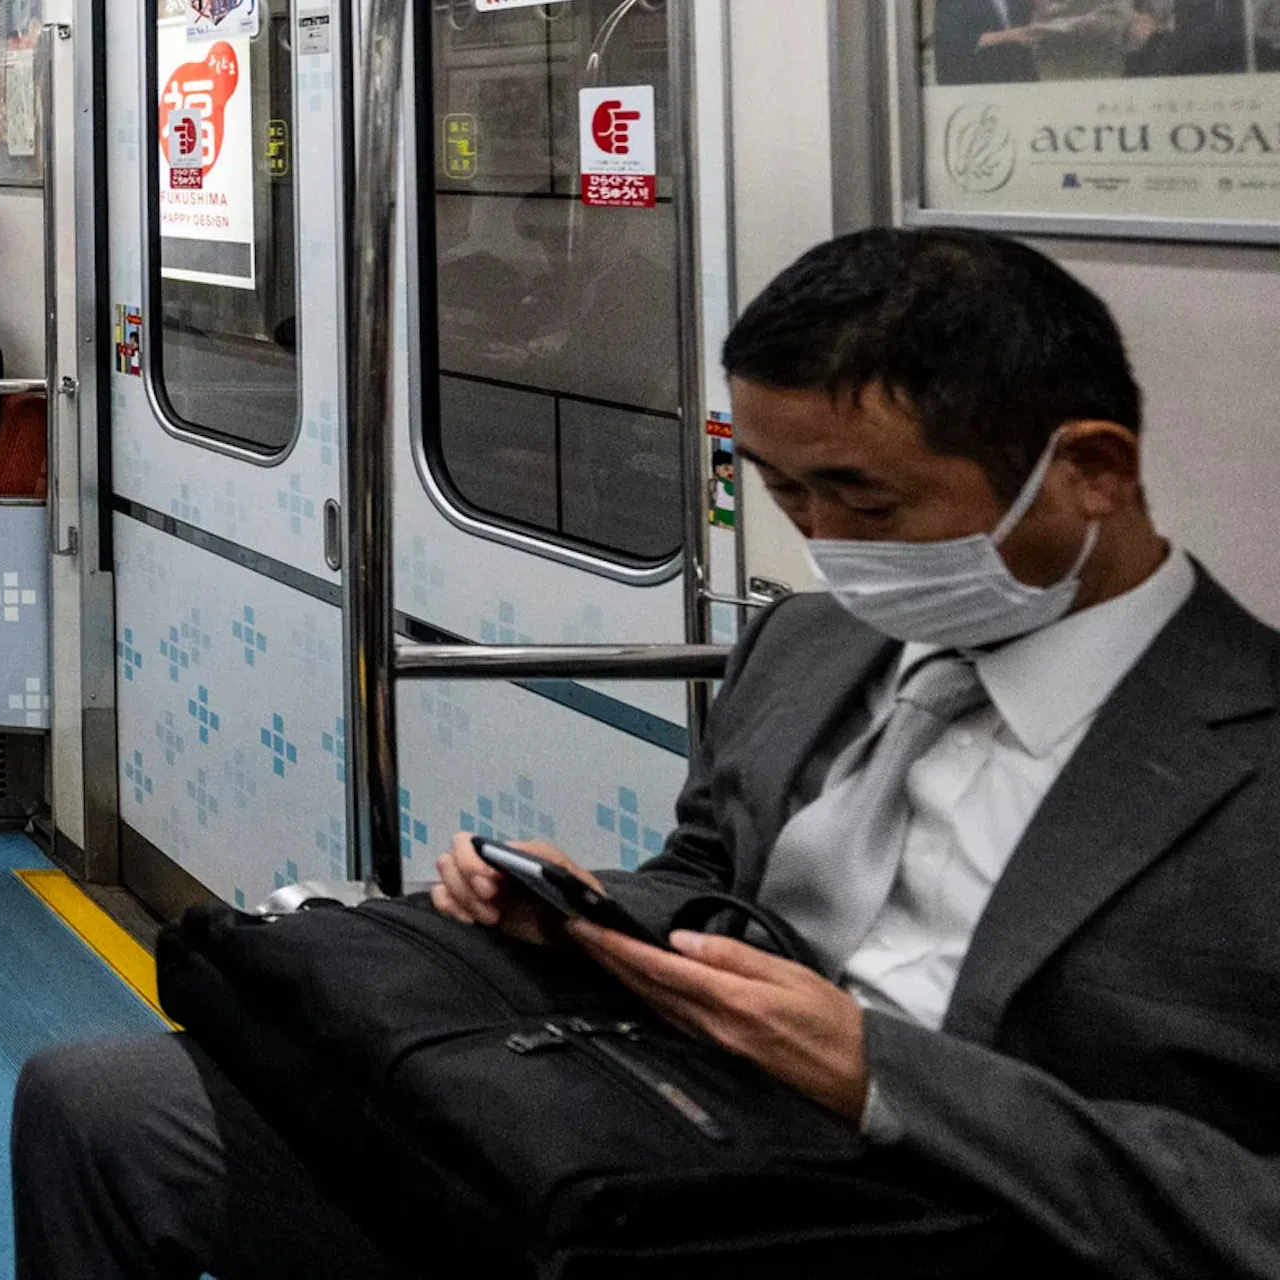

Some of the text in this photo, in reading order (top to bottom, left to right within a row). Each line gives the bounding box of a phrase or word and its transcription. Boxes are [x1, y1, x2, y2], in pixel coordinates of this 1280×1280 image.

[1030, 122, 1280, 154] acru OSA
[589, 175, 645, 186] ひらくドアに
[159, 191, 229, 207] FUKUSHIMA
[587, 185, 650, 200] ごちゅうい!
[193, 213, 230, 228] DESIGN
